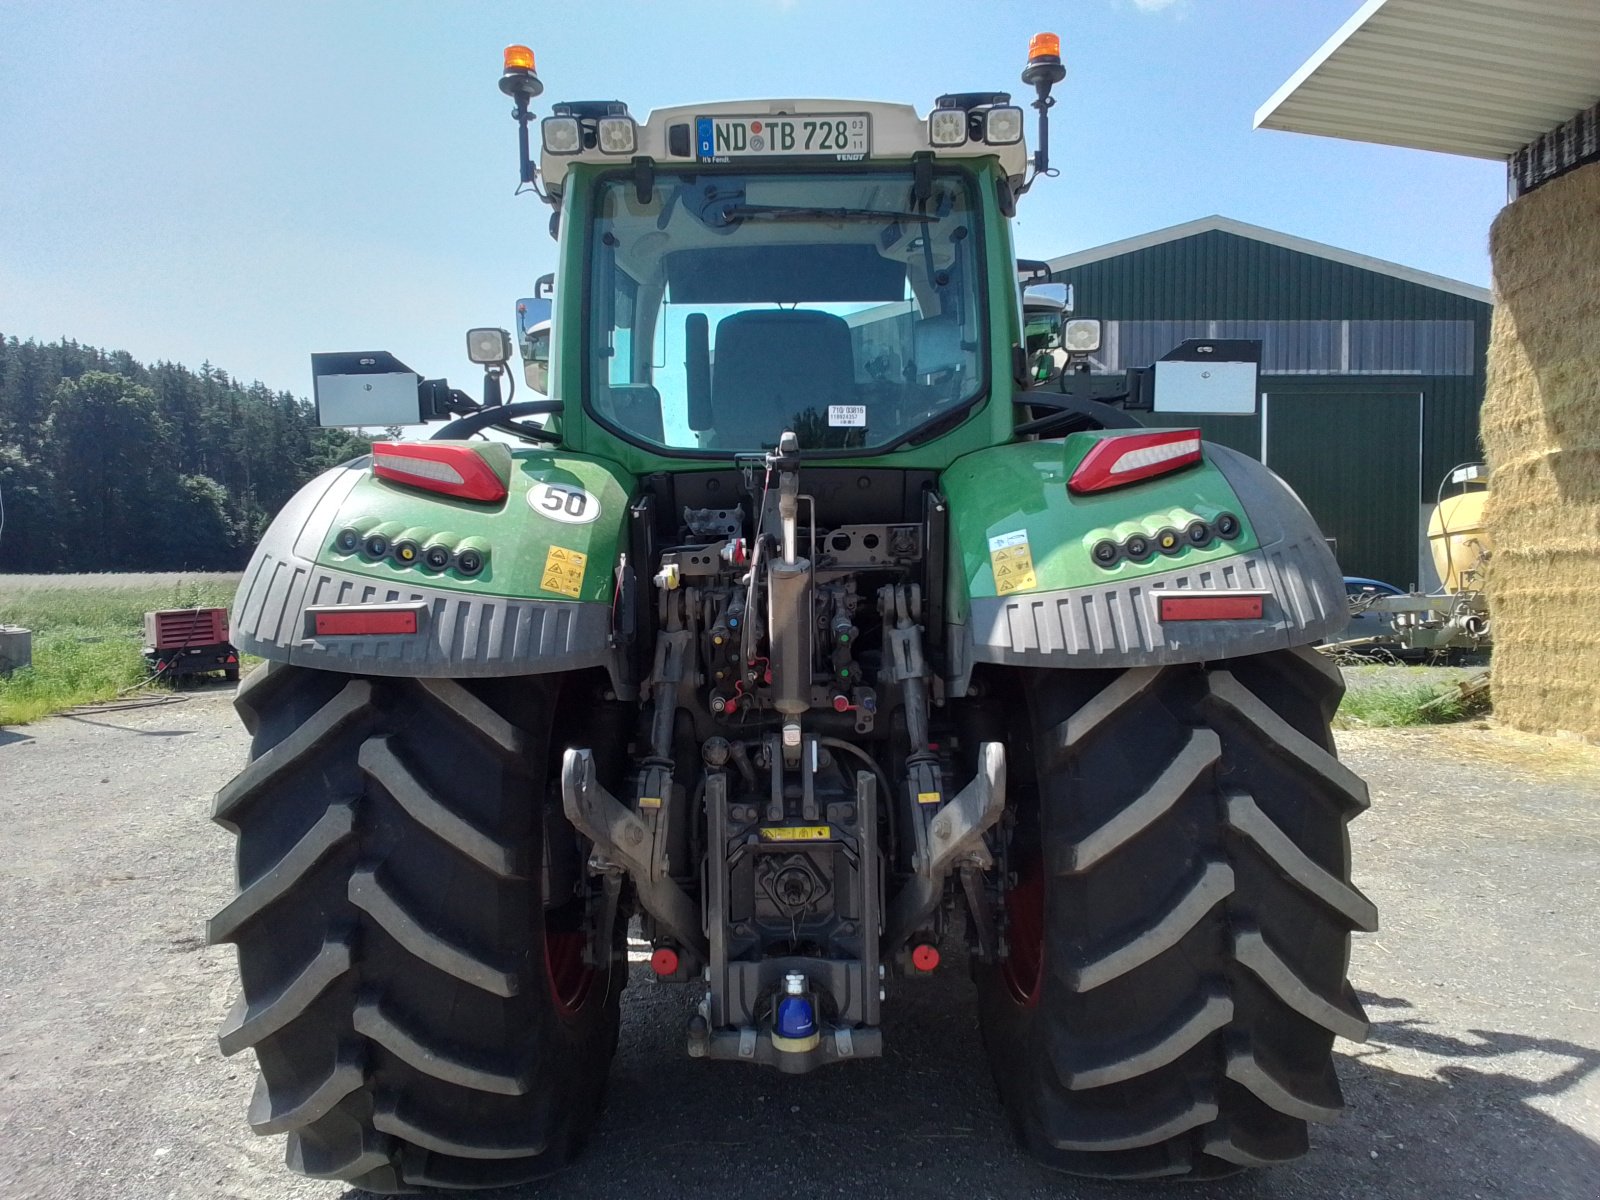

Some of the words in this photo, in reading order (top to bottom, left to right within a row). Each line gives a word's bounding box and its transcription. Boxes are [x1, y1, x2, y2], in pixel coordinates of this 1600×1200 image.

[852, 121, 863, 129] 03
[716, 123, 746, 151] ND
[765, 122, 795, 150] TB
[803, 121, 848, 150] 728
[702, 141, 709, 150] D
[853, 141, 863, 149] 11
[541, 487, 587, 516] 50
